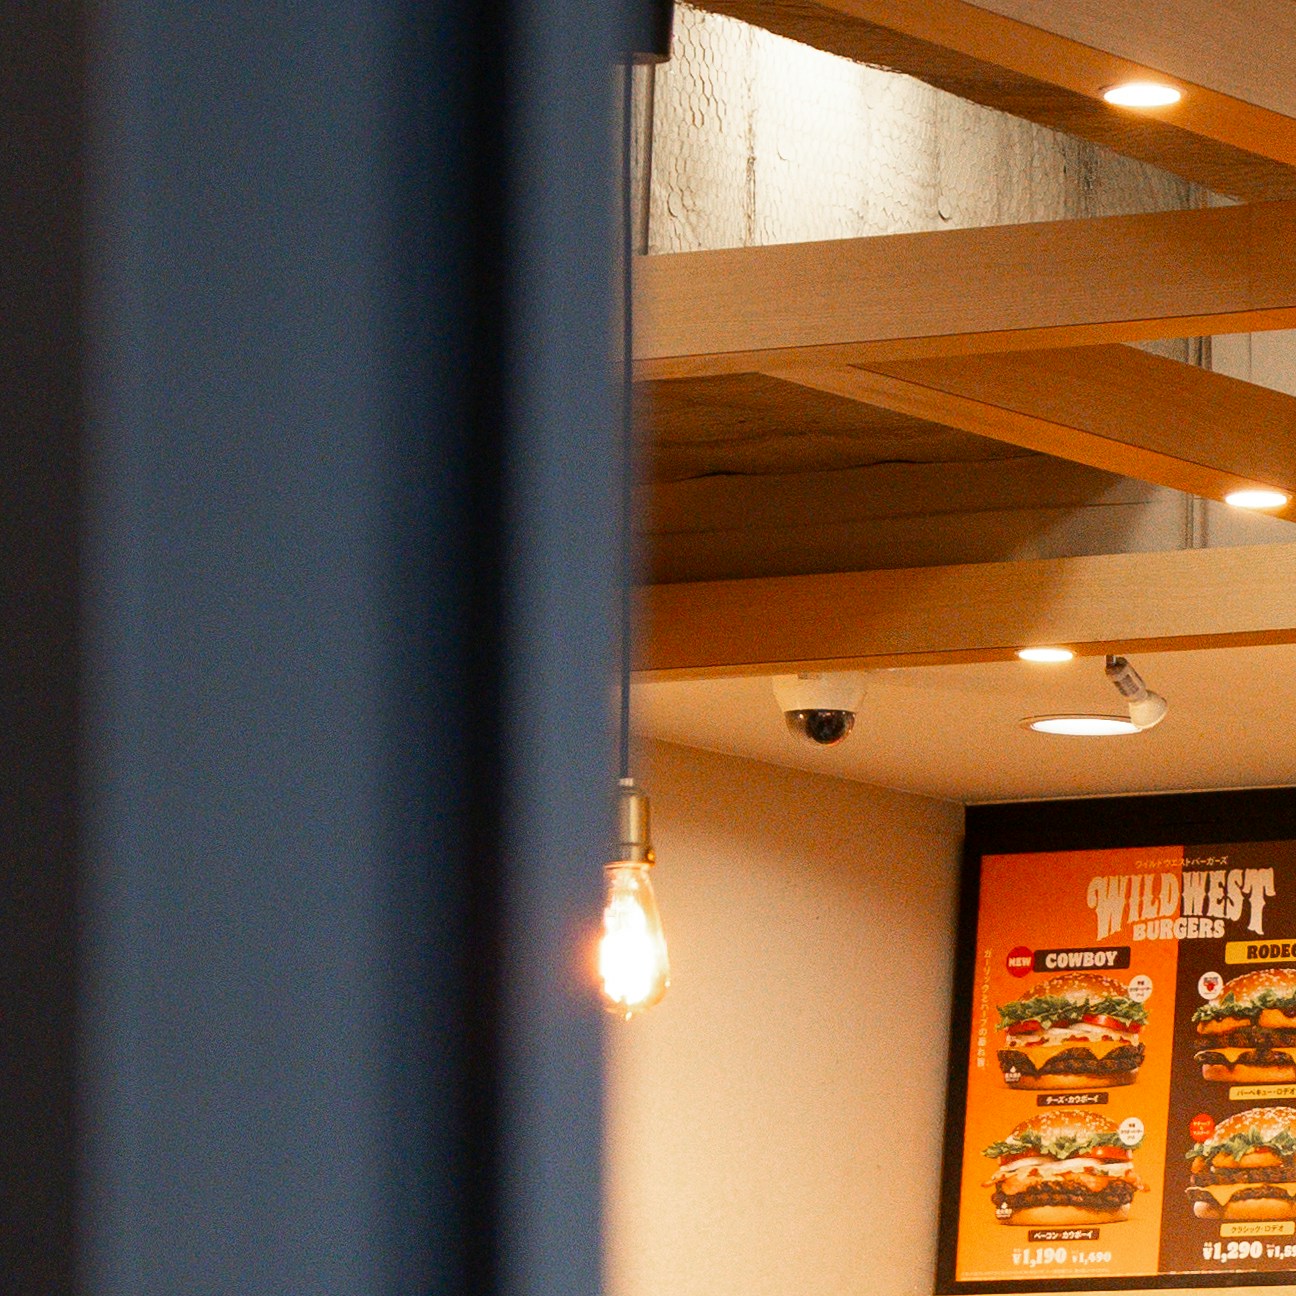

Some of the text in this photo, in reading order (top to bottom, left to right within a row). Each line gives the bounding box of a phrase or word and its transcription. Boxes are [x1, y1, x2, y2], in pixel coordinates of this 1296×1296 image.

[1087, 867, 1276, 942] WILD WEST
[1132, 918, 1226, 942] BURGERS
[1008, 956, 1032, 967] NEW
[1045, 950, 1118, 968] COWBOY
[1012, 1247, 1068, 1267] ¥1,190
[1202, 1241, 1263, 1263] ¥1,290
